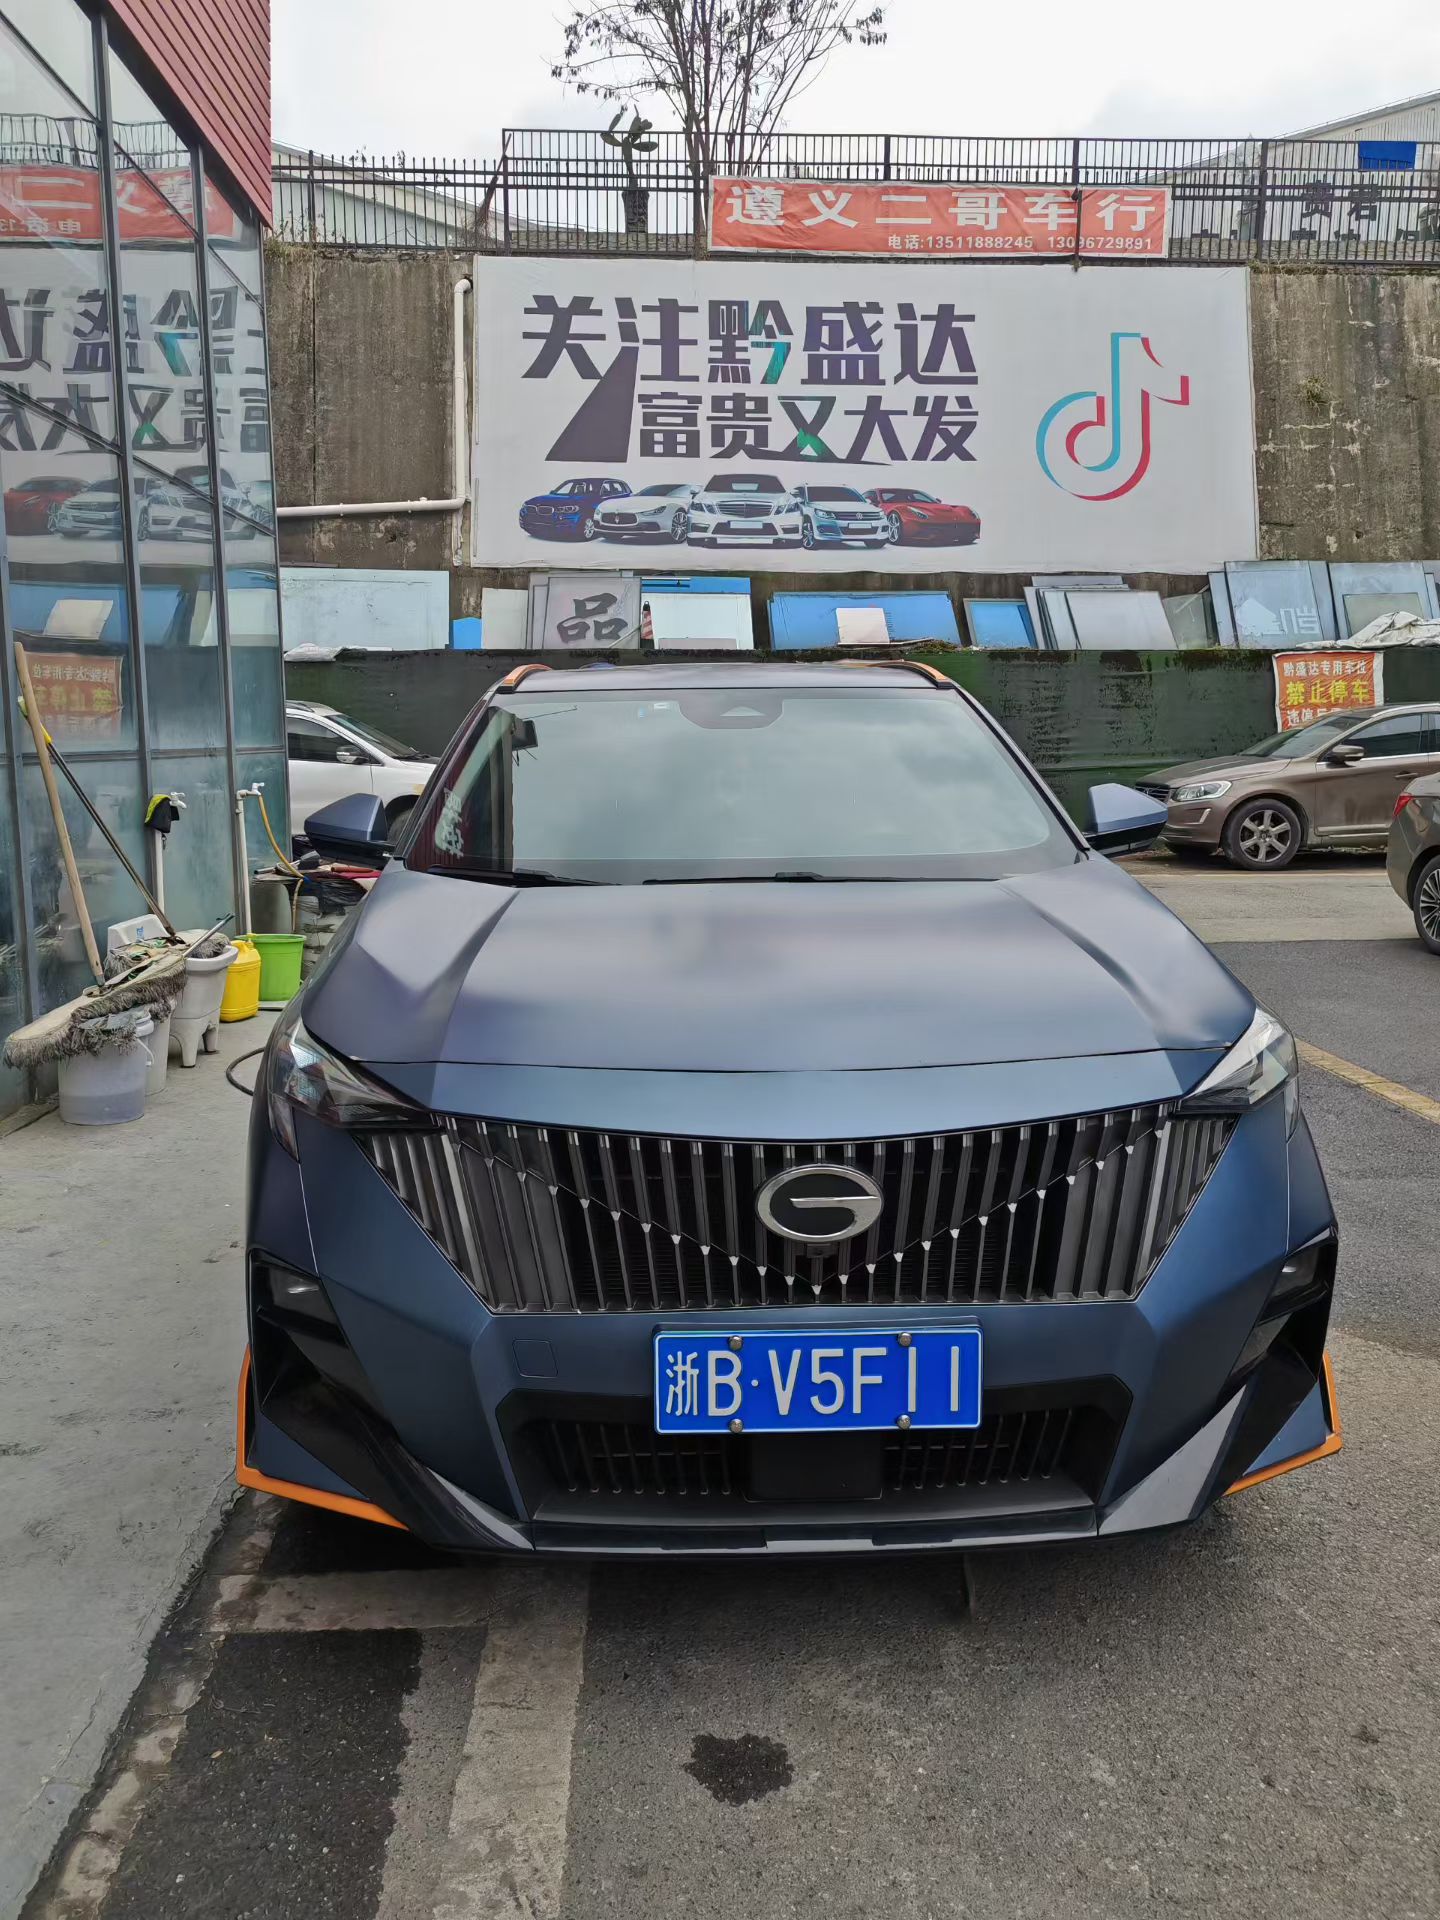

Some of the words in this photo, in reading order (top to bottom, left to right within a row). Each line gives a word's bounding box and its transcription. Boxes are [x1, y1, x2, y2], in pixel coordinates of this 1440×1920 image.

[725, 185, 1156, 231] 遵义二哥车行
[888, 233, 1033, 250] 电话:13511888245
[521, 294, 979, 387] 关注黔盛达
[637, 391, 979, 465] 富贵又大发
[557, 592, 629, 644] 品
[1286, 679, 1370, 706] 禁止停车
